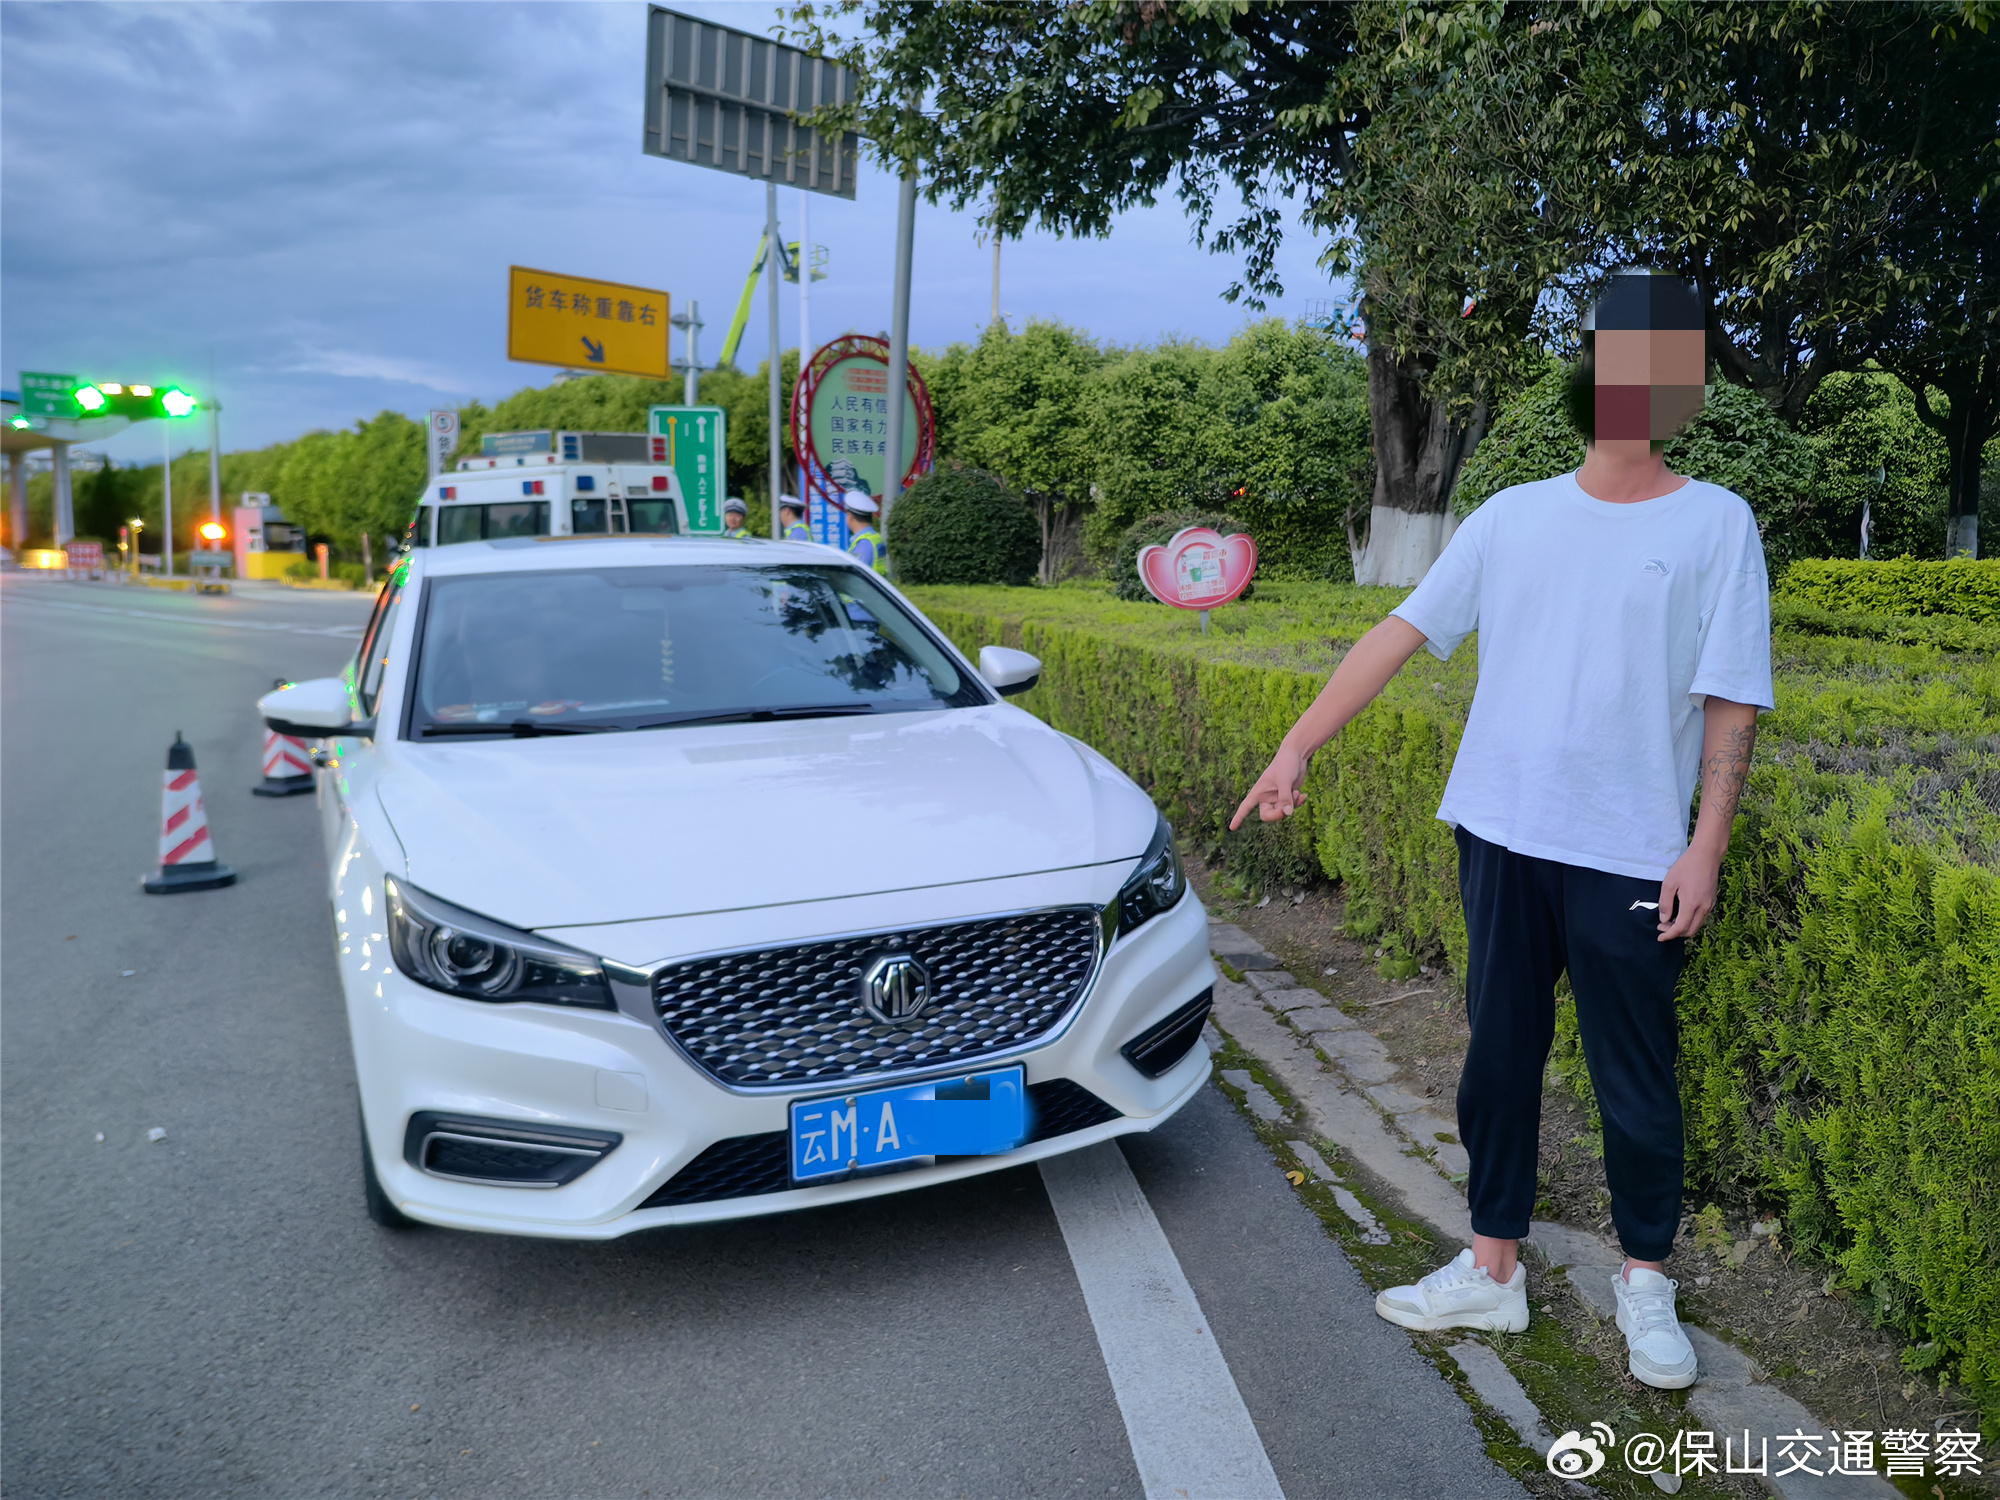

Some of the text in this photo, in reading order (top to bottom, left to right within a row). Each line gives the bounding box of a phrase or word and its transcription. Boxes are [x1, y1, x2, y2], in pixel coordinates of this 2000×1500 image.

[525, 285, 658, 327] 货车称重靠右
[698, 498, 708, 527] ETC
[874, 962, 927, 1018] MG
